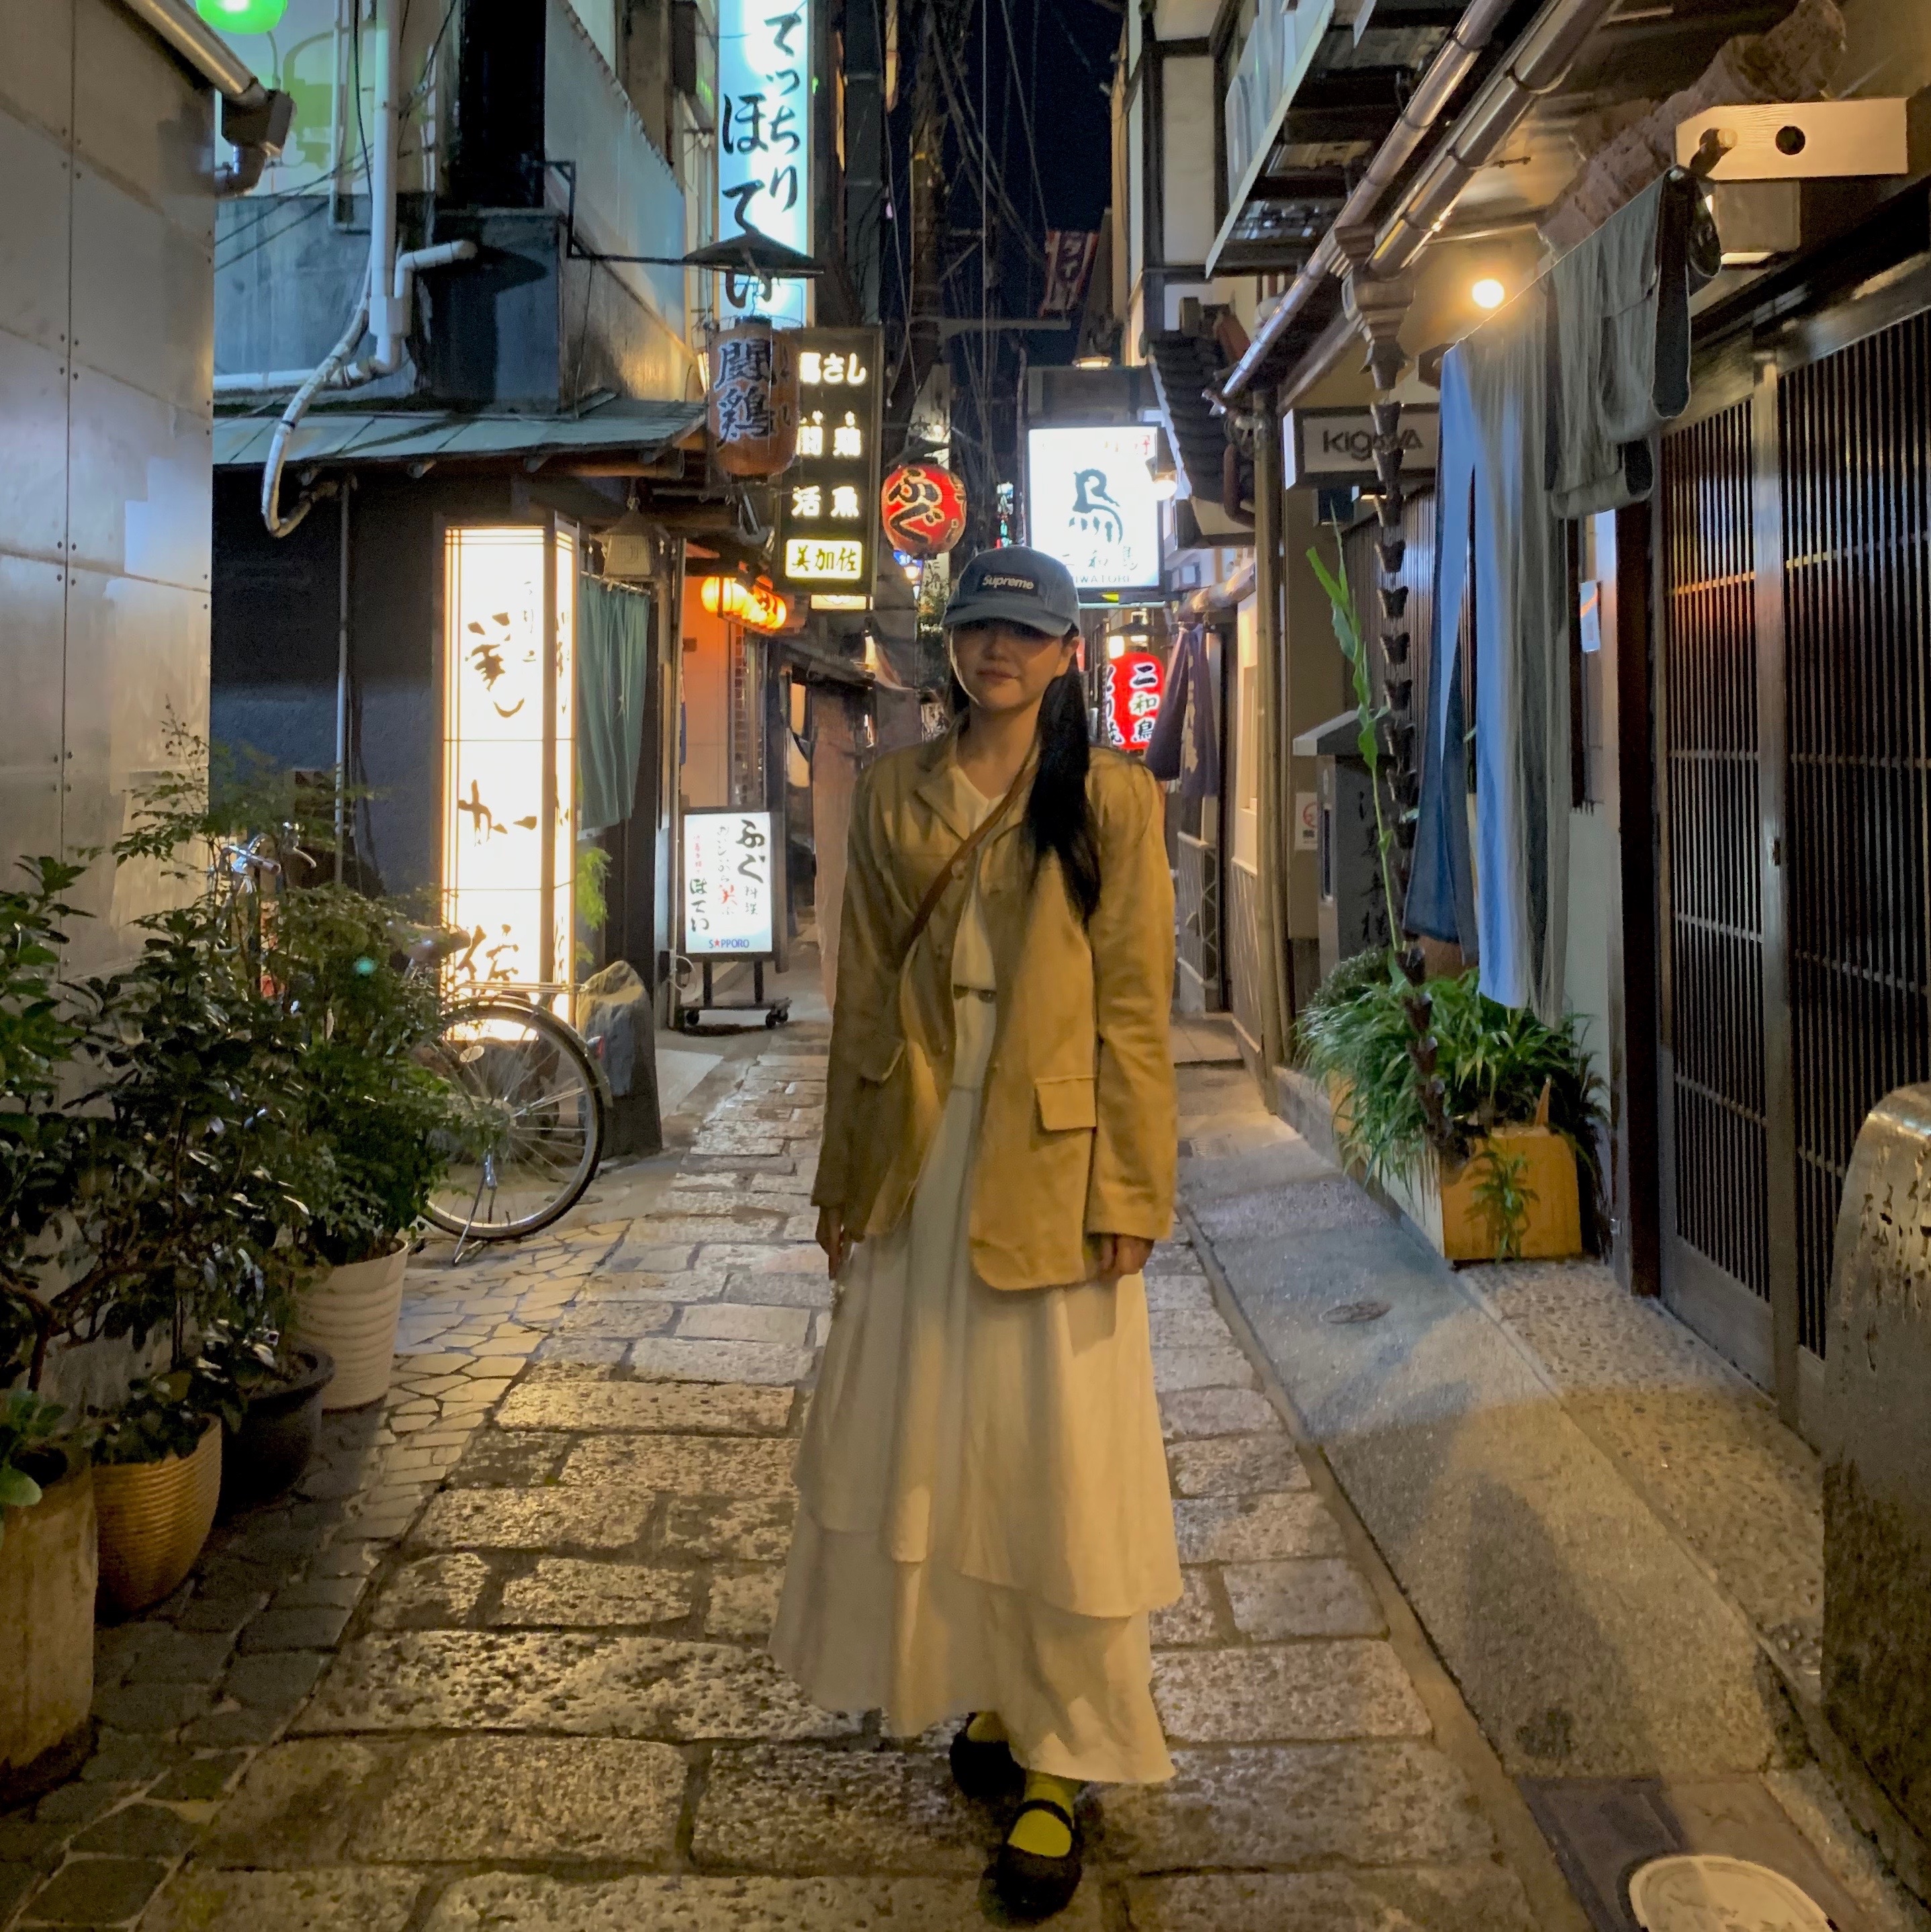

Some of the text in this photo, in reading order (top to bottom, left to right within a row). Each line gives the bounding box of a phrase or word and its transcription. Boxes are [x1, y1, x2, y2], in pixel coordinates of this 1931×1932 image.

[764, 12, 802, 212] てっちり
[791, 485, 859, 517] 活魚
[887, 468, 942, 543] ふぐ
[791, 545, 857, 572] 美加佐
[1075, 574, 1130, 584] IWATORI
[982, 574, 1034, 590] Supreme
[1130, 664, 1157, 742] 二和鳥
[690, 878, 709, 932] ほてい
